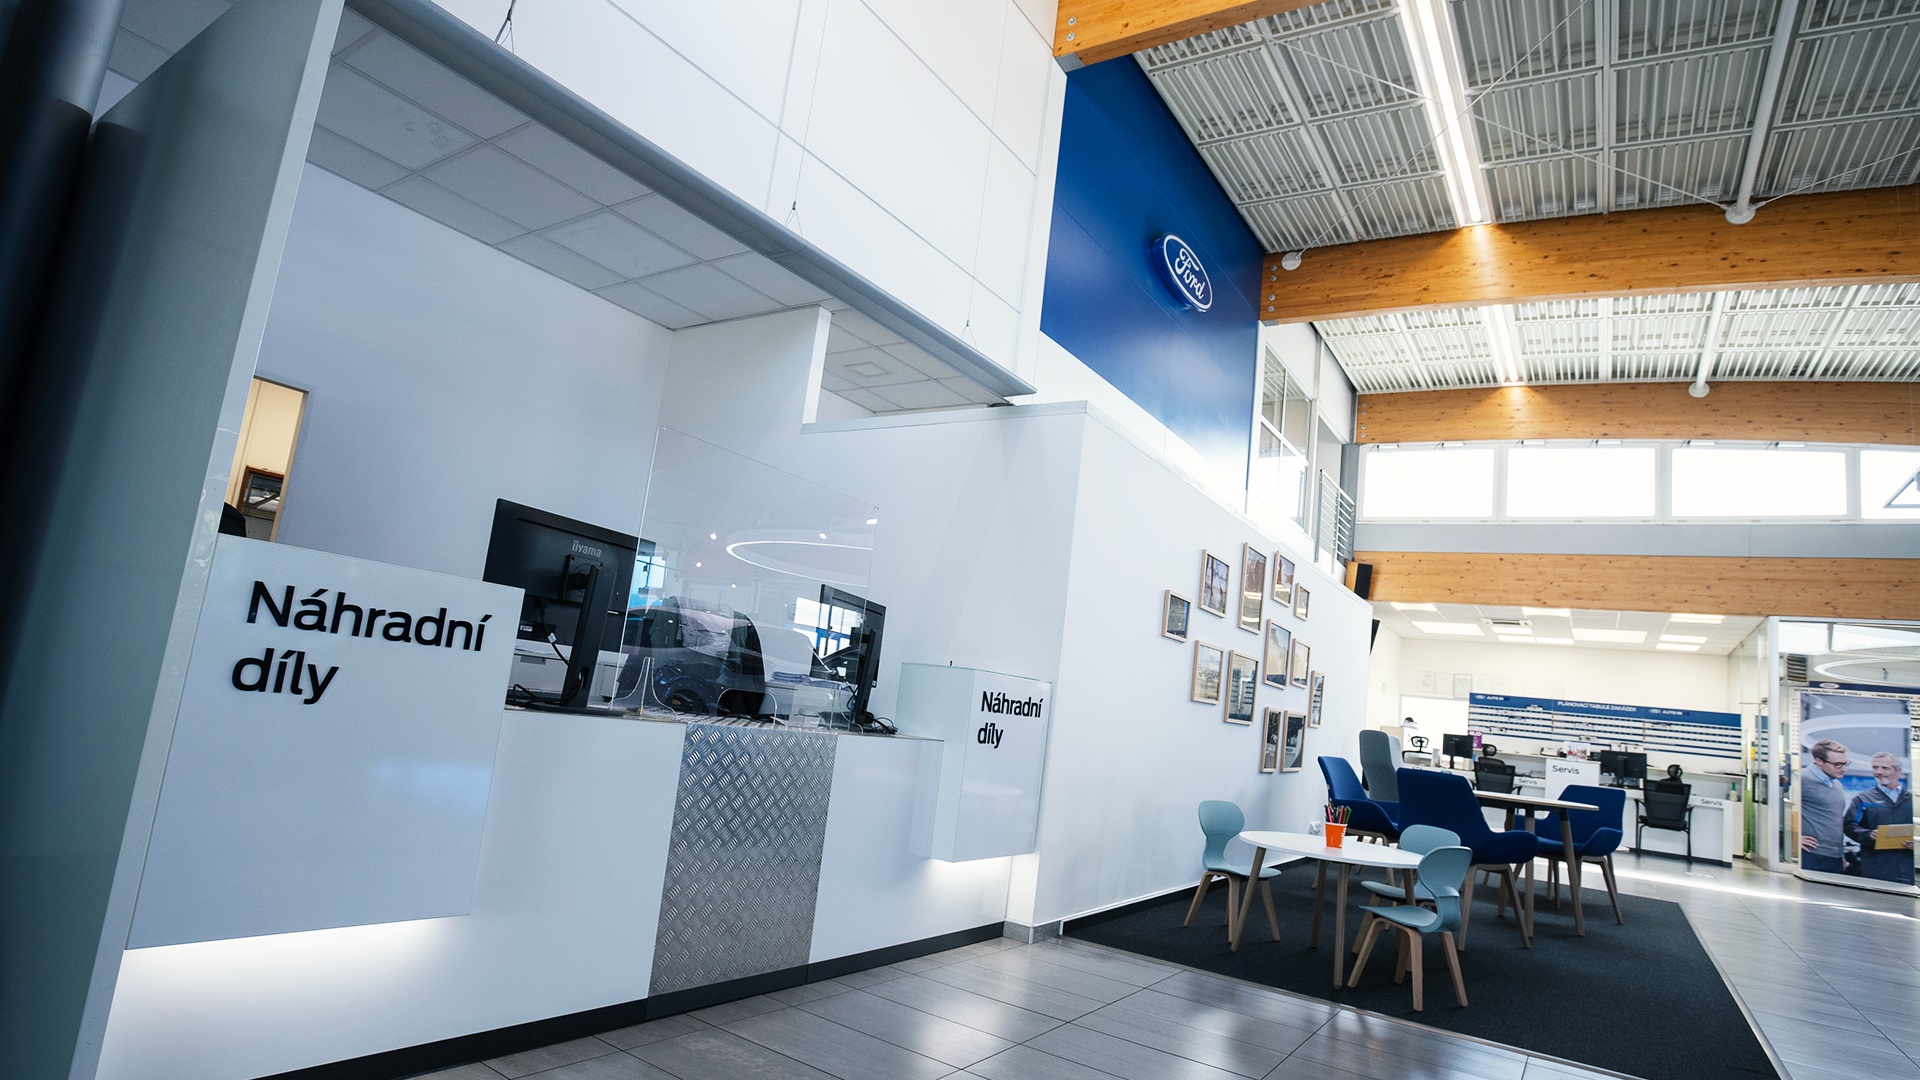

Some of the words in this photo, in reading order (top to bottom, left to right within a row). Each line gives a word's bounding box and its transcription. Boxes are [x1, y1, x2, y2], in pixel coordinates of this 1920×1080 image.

[1174, 247, 1206, 299] Ford
[571, 539, 602, 558] iiyama
[246, 580, 493, 652] Náhradní
[231, 647, 340, 705] díly
[981, 690, 1043, 718] Náhradní
[977, 722, 1004, 749] díly
[1552, 764, 1580, 774] Servis
[1700, 798, 1723, 806] Servis
